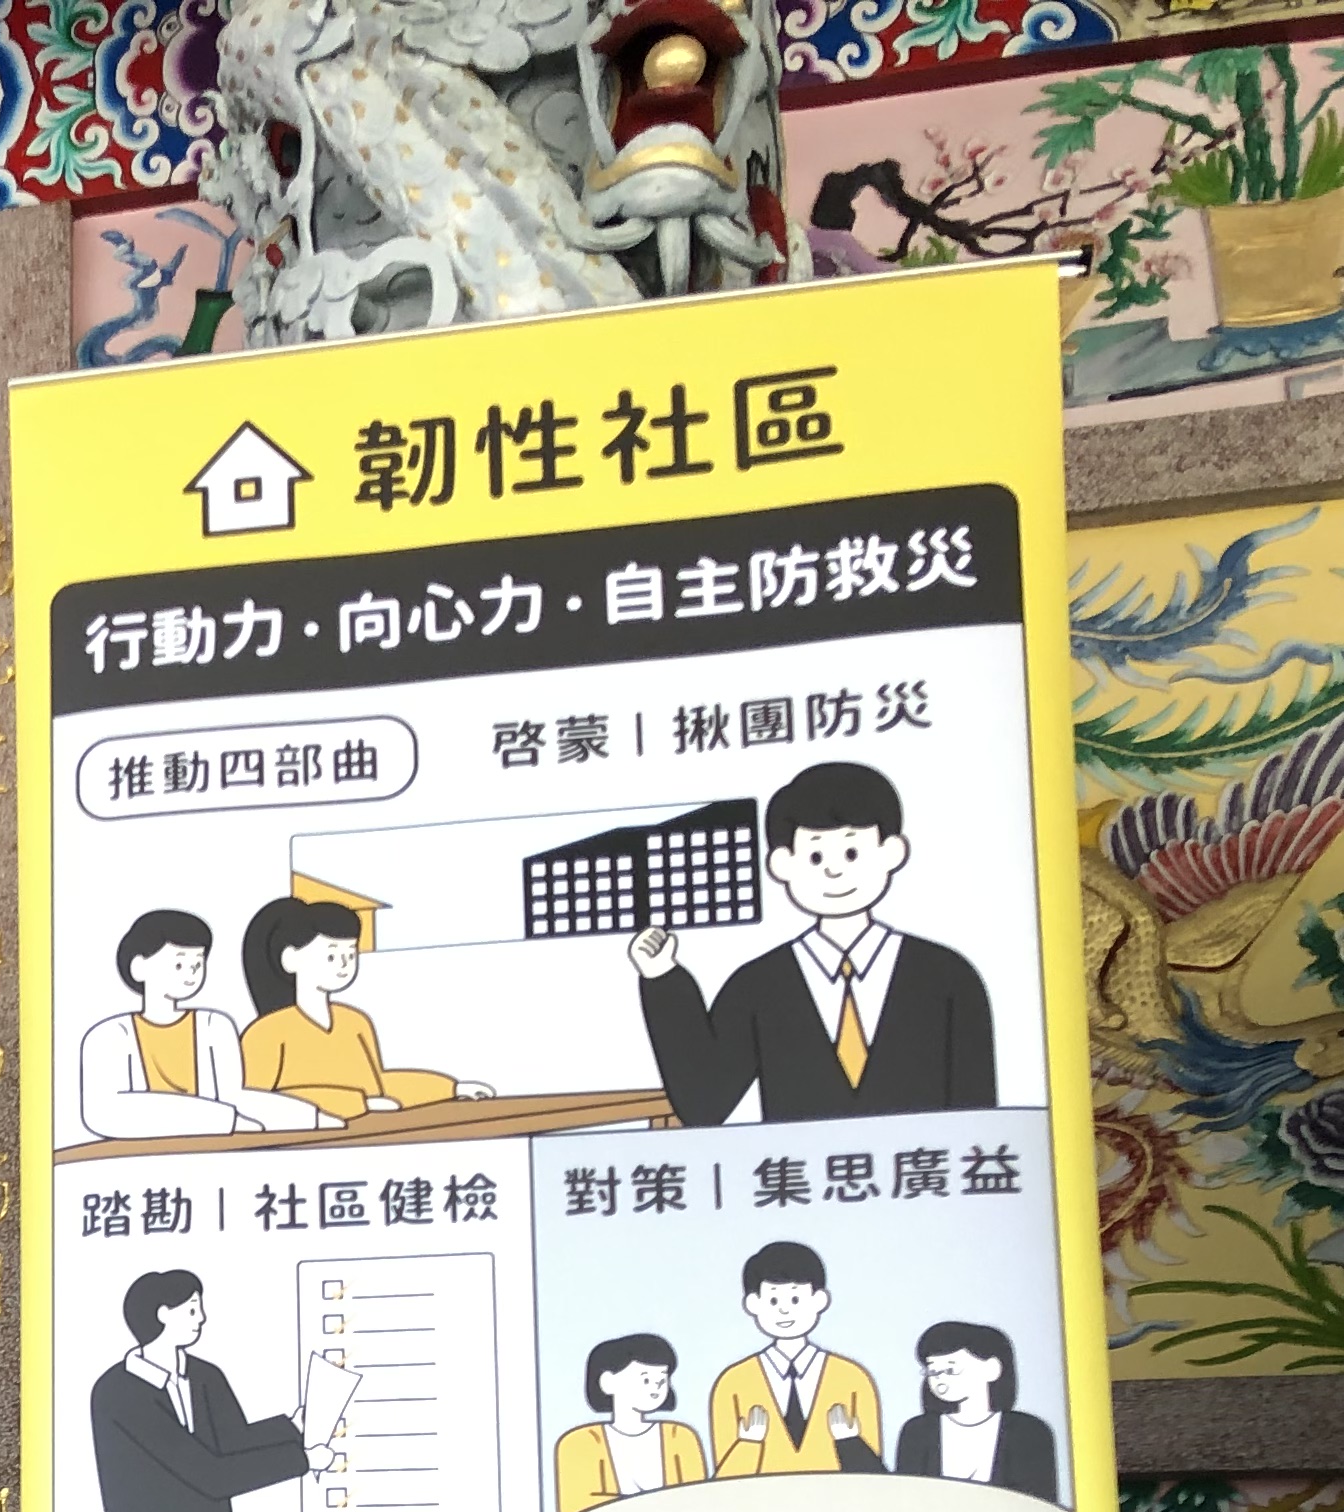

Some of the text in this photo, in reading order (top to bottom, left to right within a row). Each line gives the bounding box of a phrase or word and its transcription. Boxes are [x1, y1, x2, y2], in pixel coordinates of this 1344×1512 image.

[353, 366, 845, 512] 韌性社區
[108, 740, 381, 802] 推動四部曲
